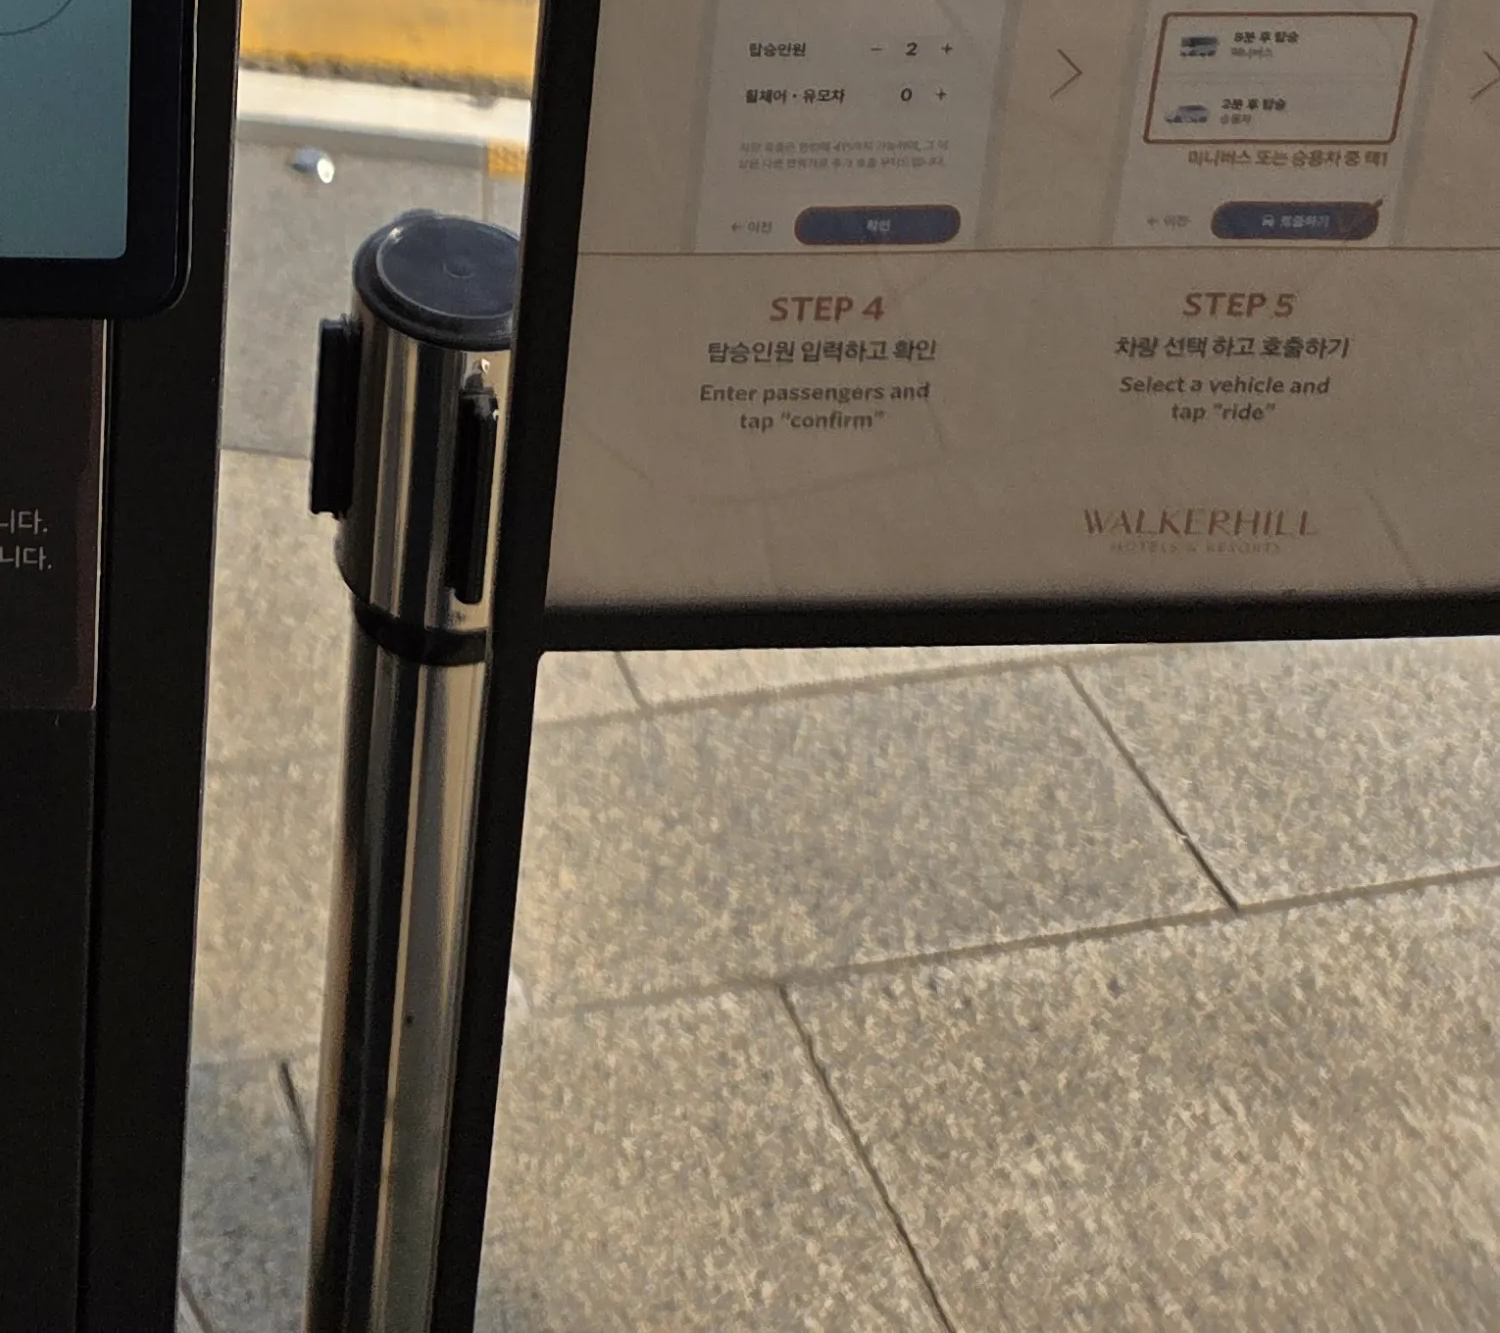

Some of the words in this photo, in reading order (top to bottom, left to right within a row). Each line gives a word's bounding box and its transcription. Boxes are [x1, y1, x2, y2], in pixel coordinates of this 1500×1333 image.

[904, 42, 918, 57] 2
[802, 88, 845, 104] 유모차
[900, 88, 913, 103] 0
[769, 297, 854, 321] STEP
[861, 296, 886, 320] 4
[1182, 292, 1268, 318] STEP
[1274, 292, 1297, 318] 5
[708, 340, 795, 363] 탑승인원
[801, 340, 888, 363] 입력하고
[893, 339, 937, 362] 확인
[1114, 336, 1159, 358] 차량
[1262, 336, 1350, 359] 호출하기
[700, 383, 758, 401] Enter
[763, 385, 885, 404] passengers
[890, 381, 931, 401] and
[1119, 376, 1185, 394] Select
[1190, 379, 1203, 394] a
[1210, 376, 1285, 394] vehicle
[1290, 377, 1331, 394] and
[740, 413, 774, 432] tap
[1171, 405, 1206, 423] tap
[1083, 508, 1320, 536] WALKERHILL
